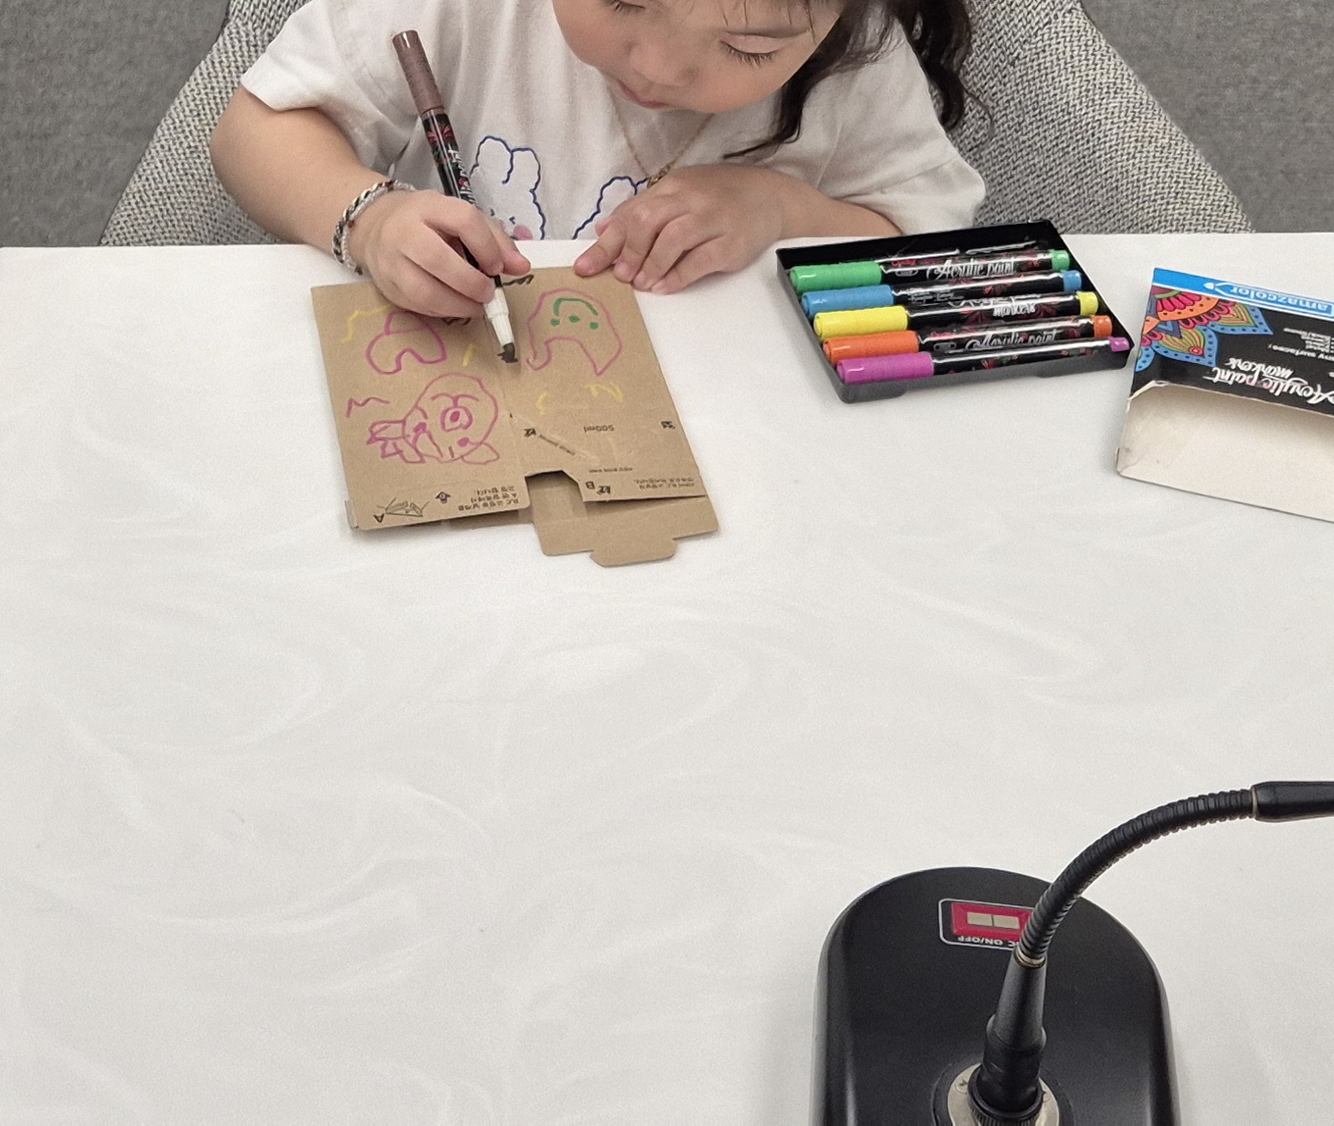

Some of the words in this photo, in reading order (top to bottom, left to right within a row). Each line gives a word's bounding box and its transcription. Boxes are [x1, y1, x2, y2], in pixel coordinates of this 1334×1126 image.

[1229, 285, 1329, 311] amazcolor
[1225, 357, 1294, 378] markers
[1202, 366, 1261, 386] paint
[584, 424, 615, 433] 500ml
[585, 481, 596, 490] B
[373, 513, 384, 523] A
